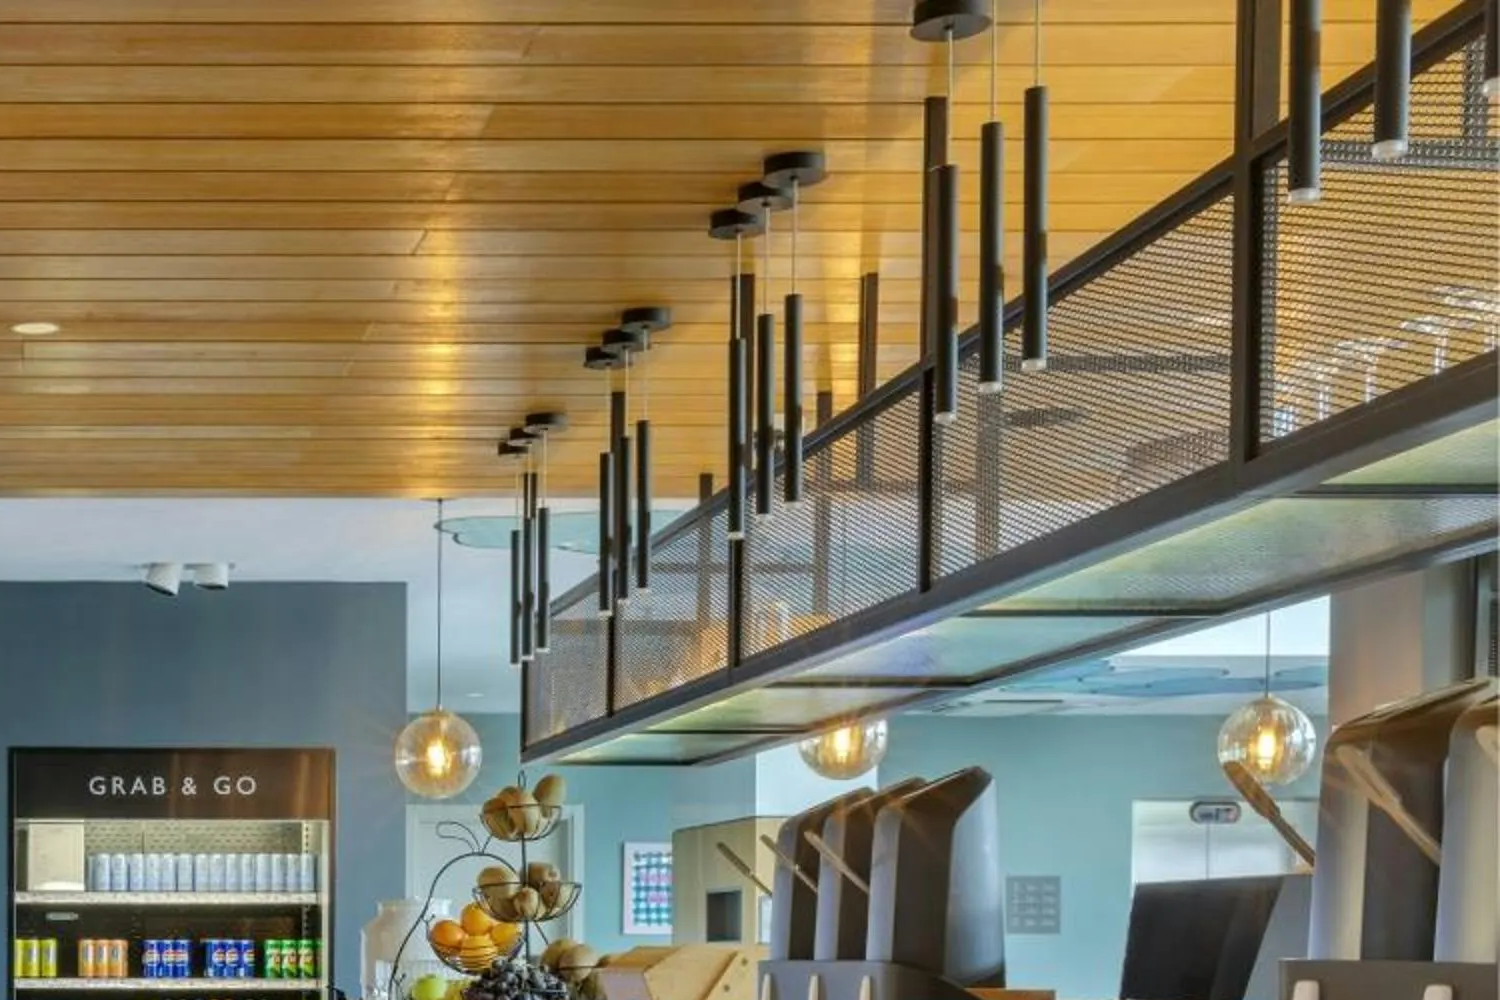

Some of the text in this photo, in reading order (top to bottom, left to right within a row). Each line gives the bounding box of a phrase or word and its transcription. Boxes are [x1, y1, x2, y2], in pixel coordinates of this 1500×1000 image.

[88, 775, 257, 796] GRAB & GO
